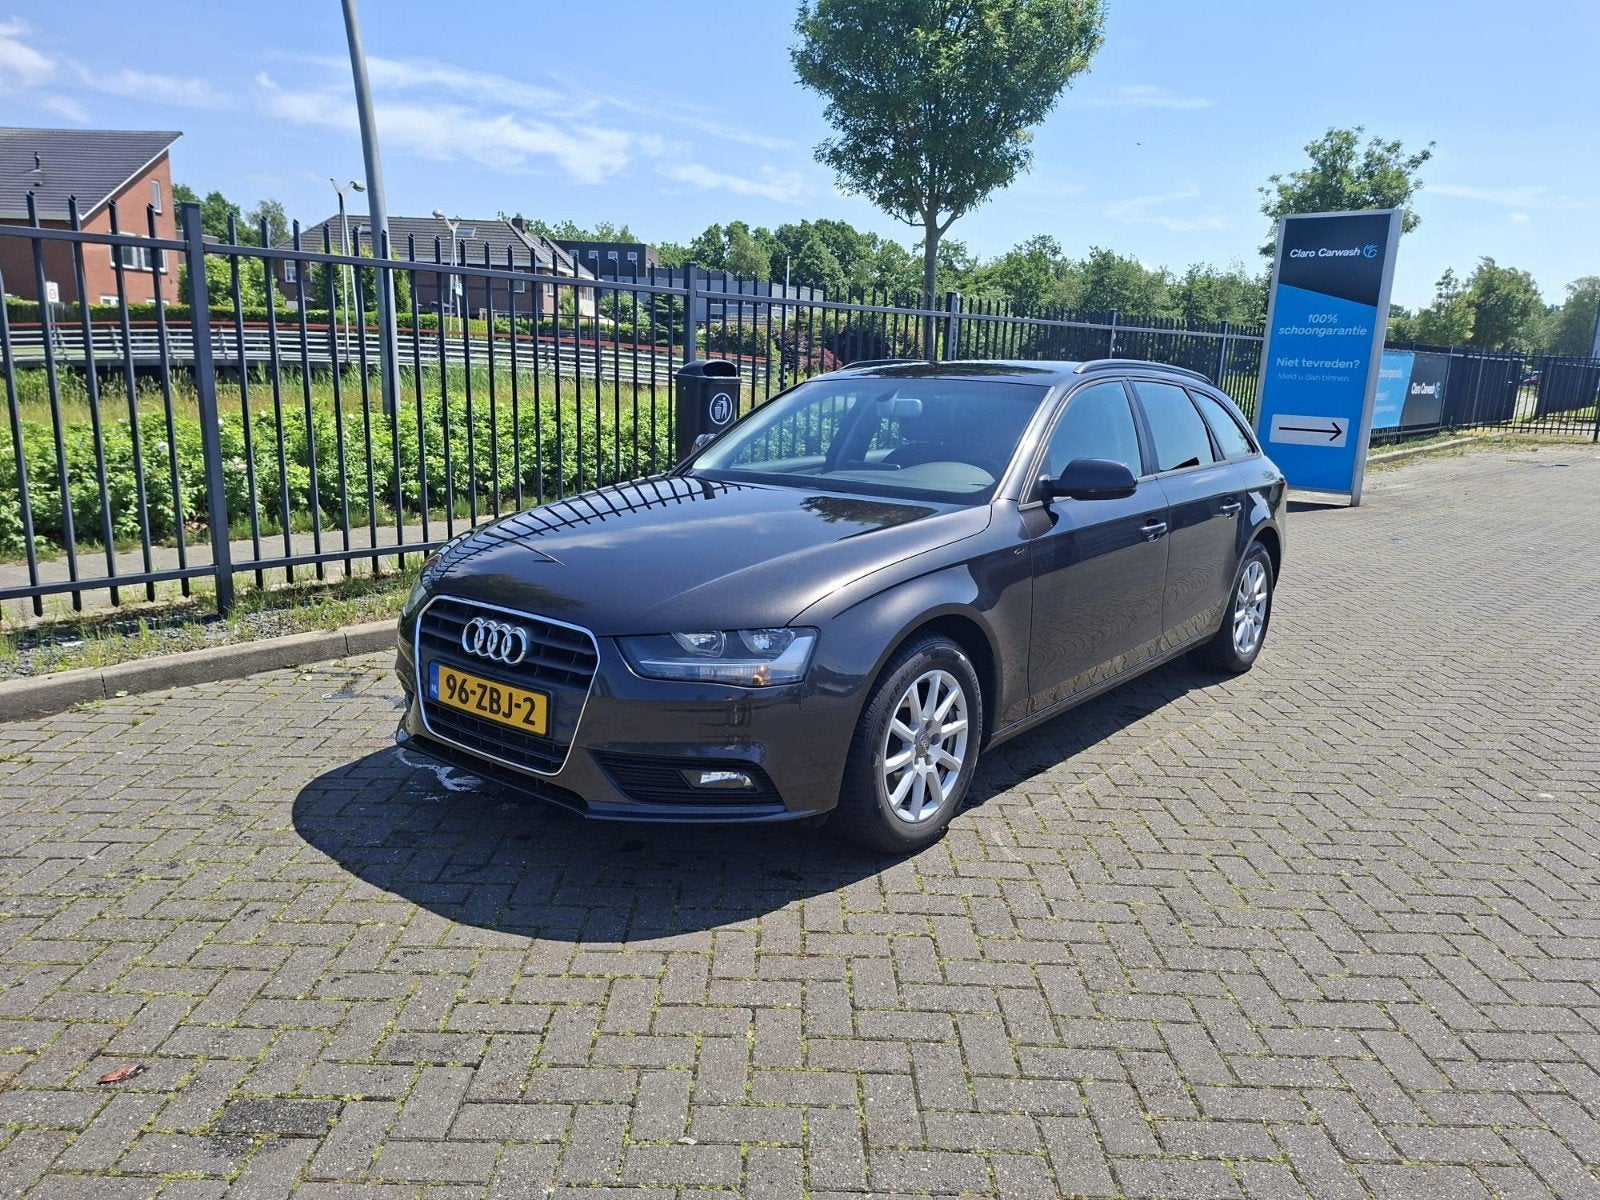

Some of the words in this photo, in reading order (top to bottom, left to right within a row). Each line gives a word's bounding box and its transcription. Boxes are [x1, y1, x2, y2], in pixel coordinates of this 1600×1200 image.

[1290, 248, 1316, 258] Claro
[1318, 247, 1360, 257] Carwash
[1307, 313, 1338, 324] 100%
[1278, 325, 1367, 337] schoongarantie
[1276, 357, 1300, 367] Niet
[1301, 358, 1361, 369] tevreden?
[1277, 372, 1297, 380] Meld
[1305, 372, 1320, 381] dan
[1321, 373, 1350, 382] binnen
[445, 673, 536, 726] 96-ZBJ-2
